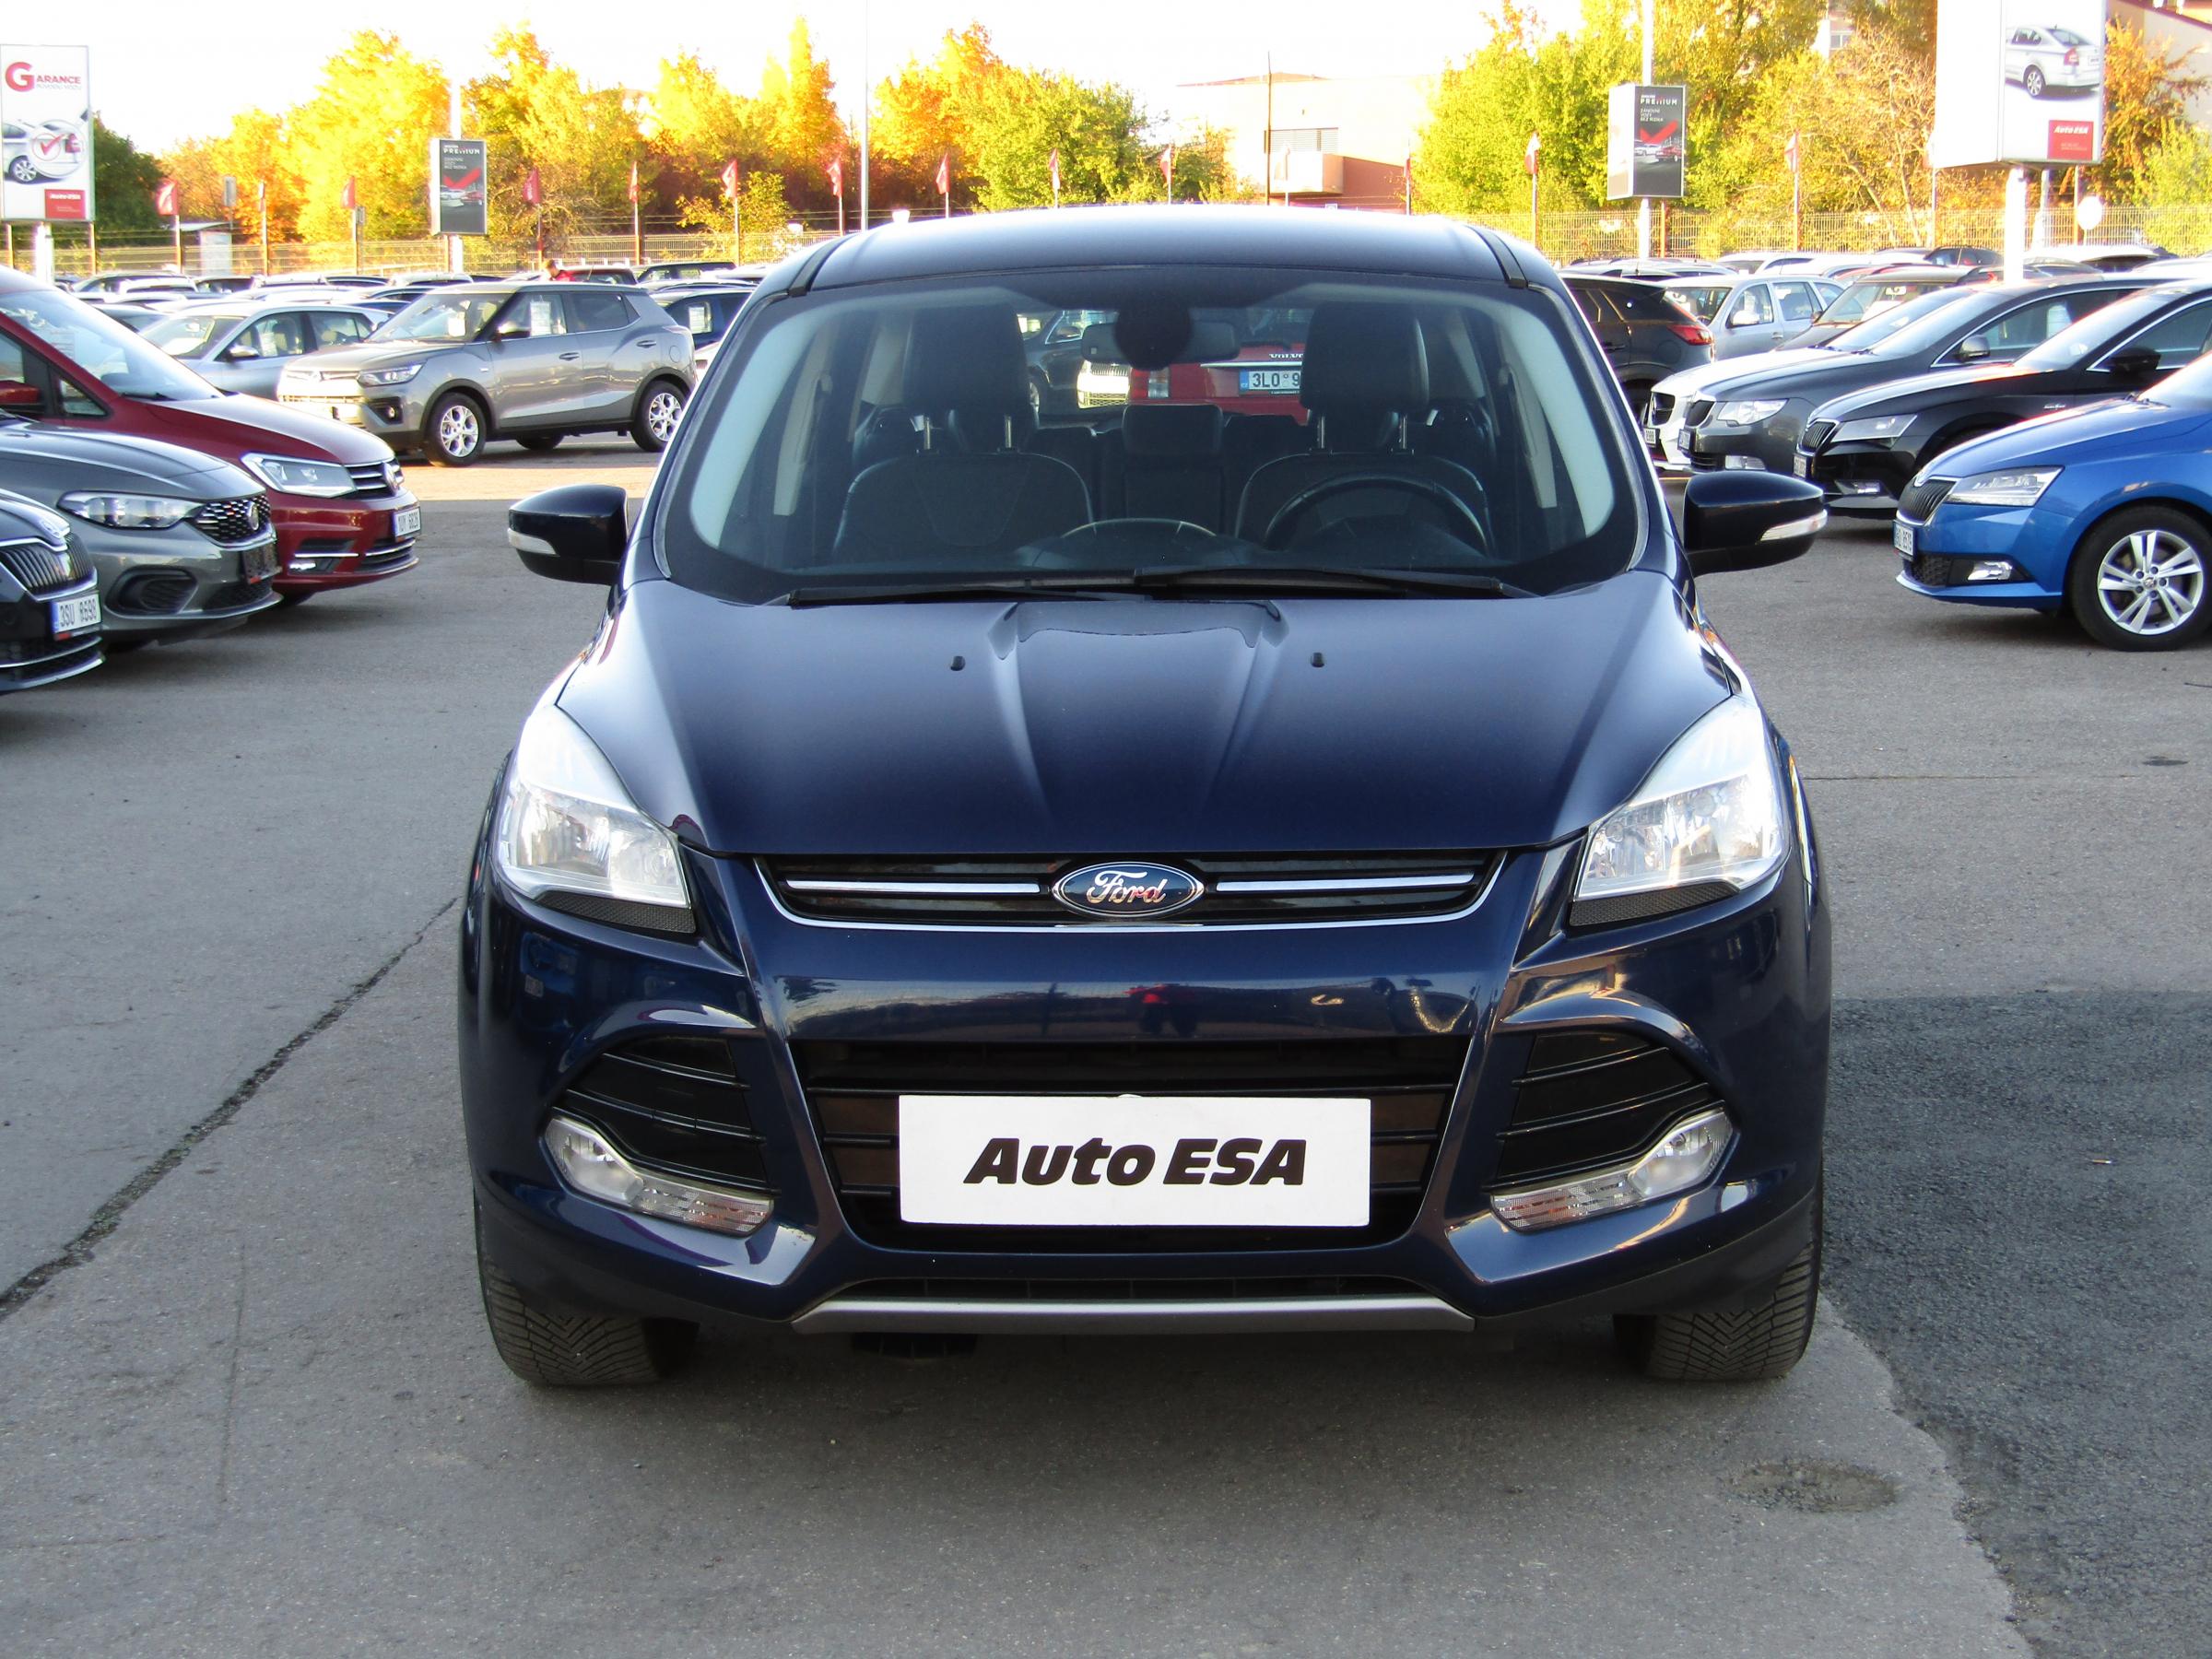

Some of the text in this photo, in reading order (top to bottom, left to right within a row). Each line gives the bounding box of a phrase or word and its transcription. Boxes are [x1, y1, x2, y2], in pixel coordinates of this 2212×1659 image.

[6, 62, 81, 91] GARANCE
[1086, 870, 1168, 904] Ford
[963, 1137, 1307, 1186] Auto ESA
